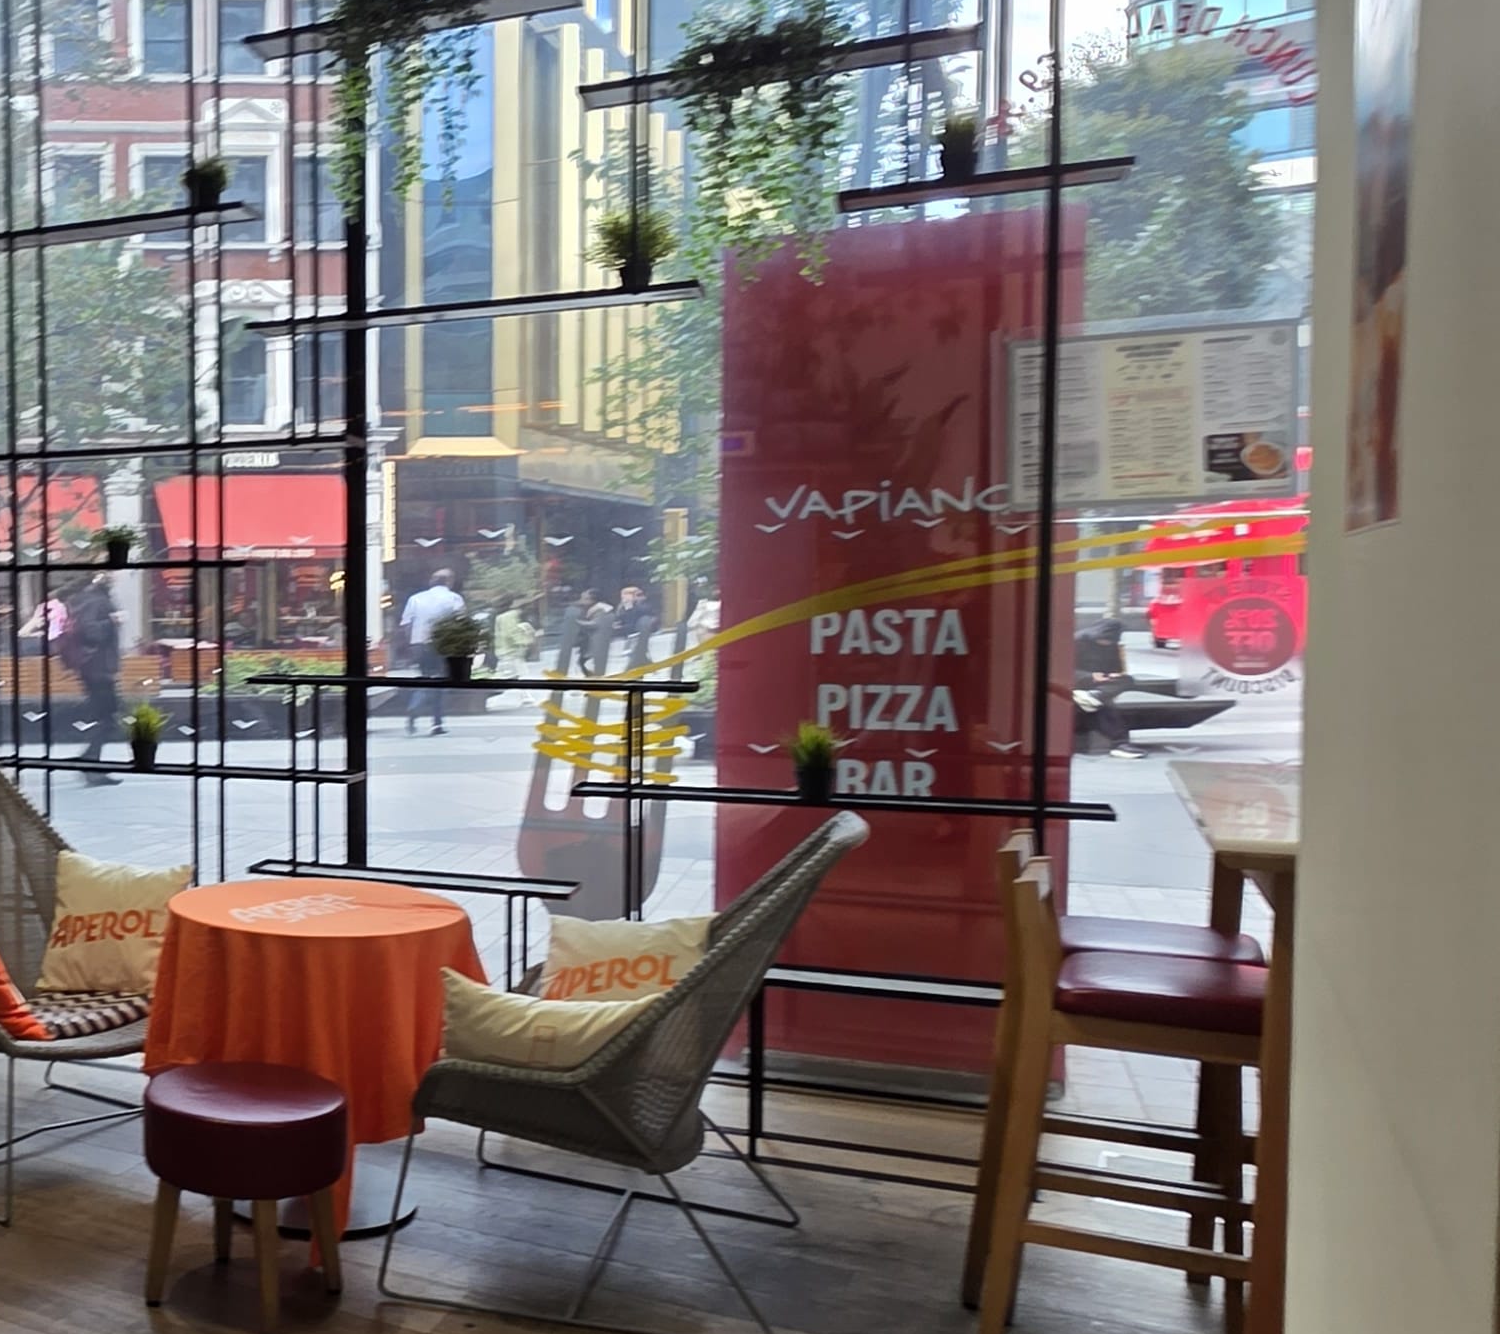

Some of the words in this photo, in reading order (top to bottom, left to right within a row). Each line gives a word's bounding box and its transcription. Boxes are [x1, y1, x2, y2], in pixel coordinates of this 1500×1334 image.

[810, 609, 968, 655] PASTA
[816, 683, 959, 732] PIZZA
[834, 758, 937, 798] BAR
[51, 908, 167, 949] APEROL
[543, 953, 678, 1001] APEROL
